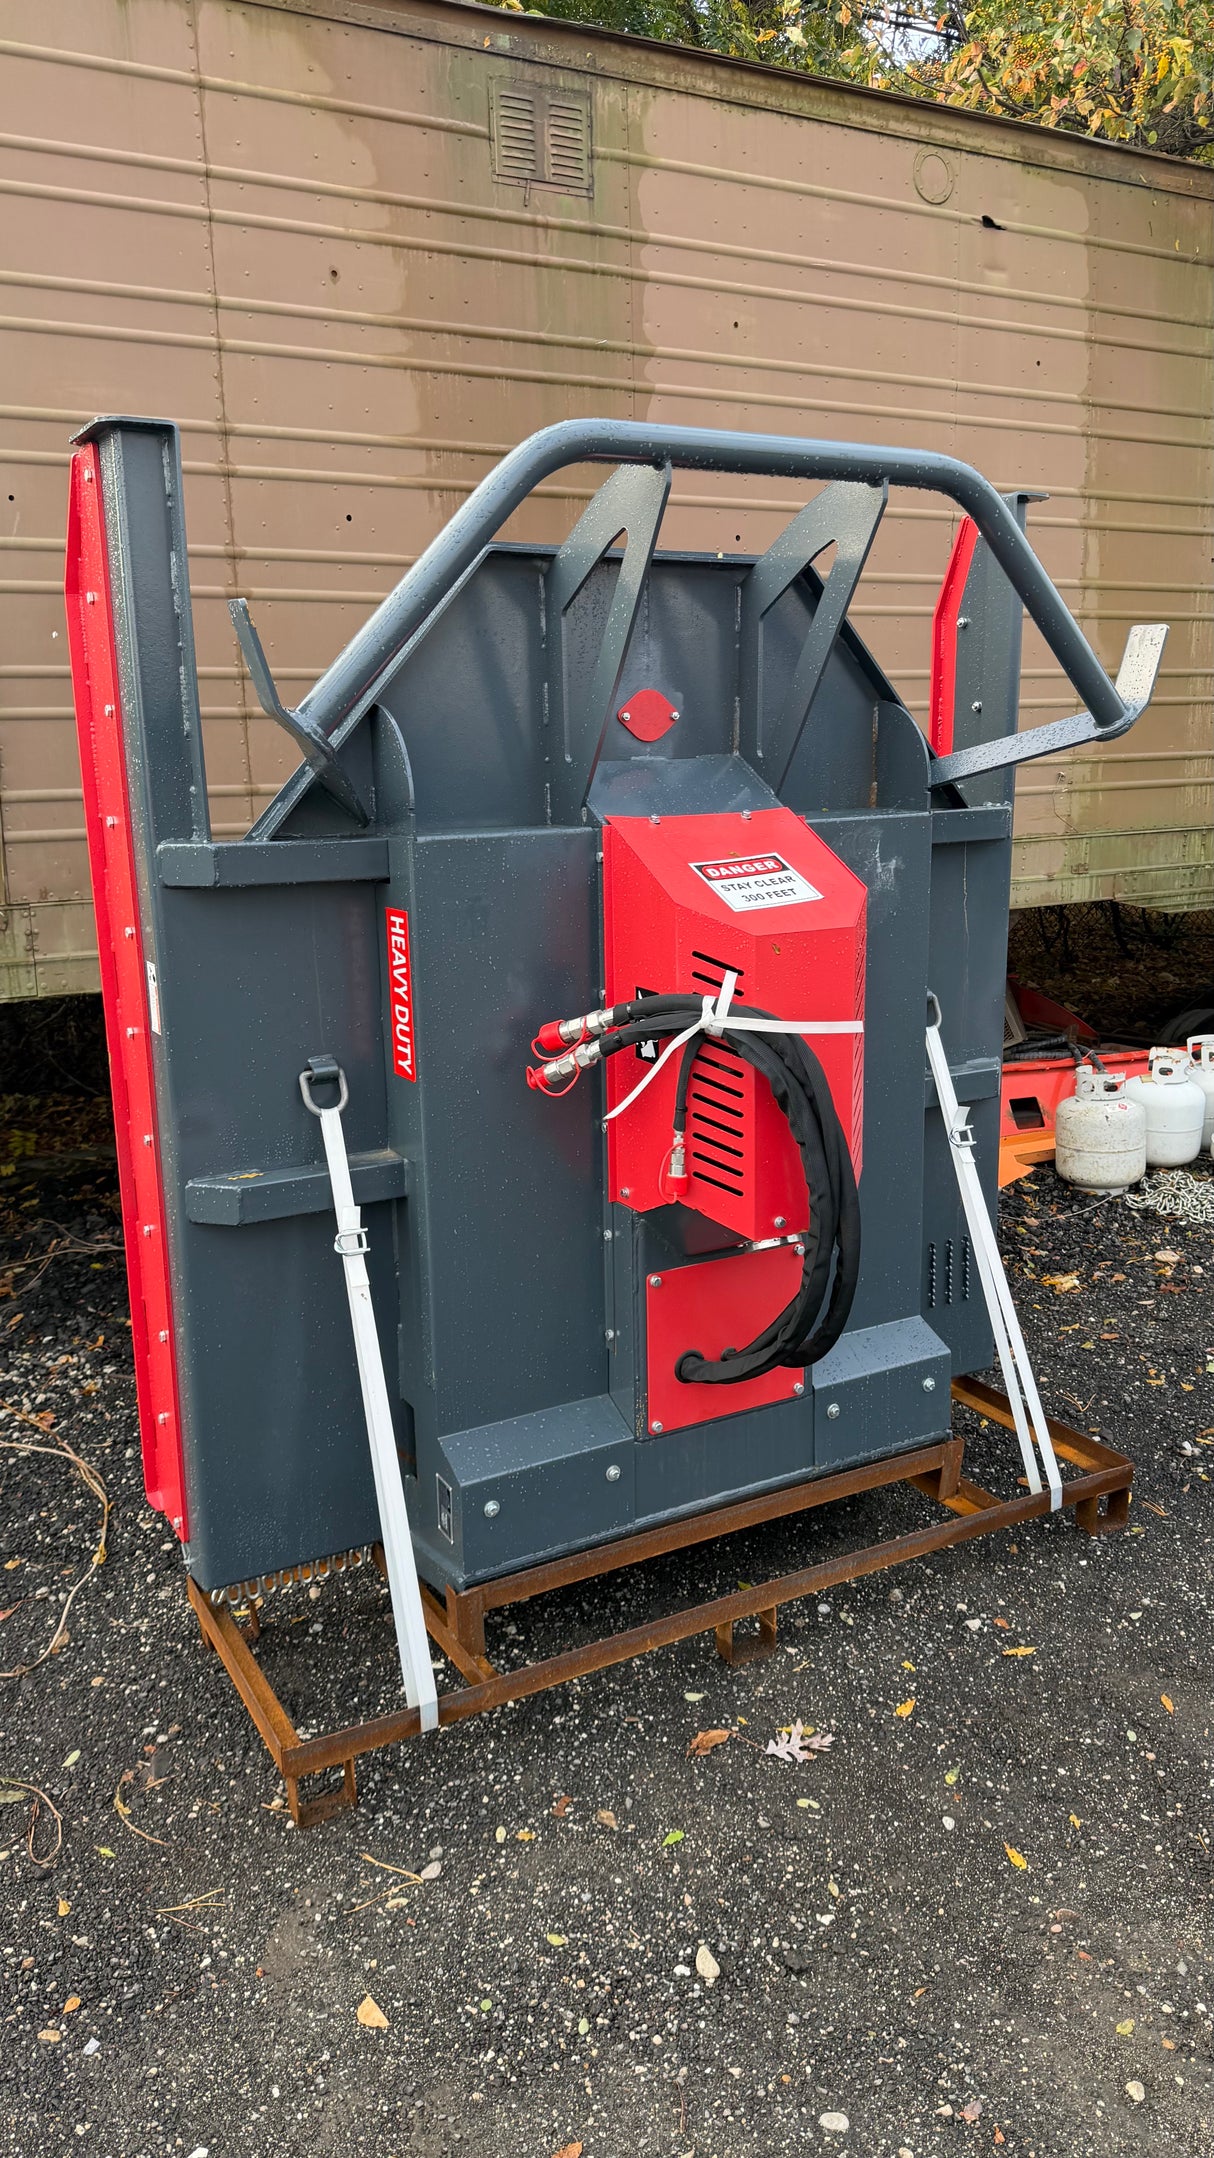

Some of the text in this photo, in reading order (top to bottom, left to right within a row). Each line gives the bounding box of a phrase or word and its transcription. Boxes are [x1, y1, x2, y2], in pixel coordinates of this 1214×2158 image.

[705, 860, 780, 877] DANGER
[720, 875, 797, 892] STAY CLEAR
[741, 888, 797, 903] 300 FEET
[390, 915, 413, 1076] HEAVY DUTY
